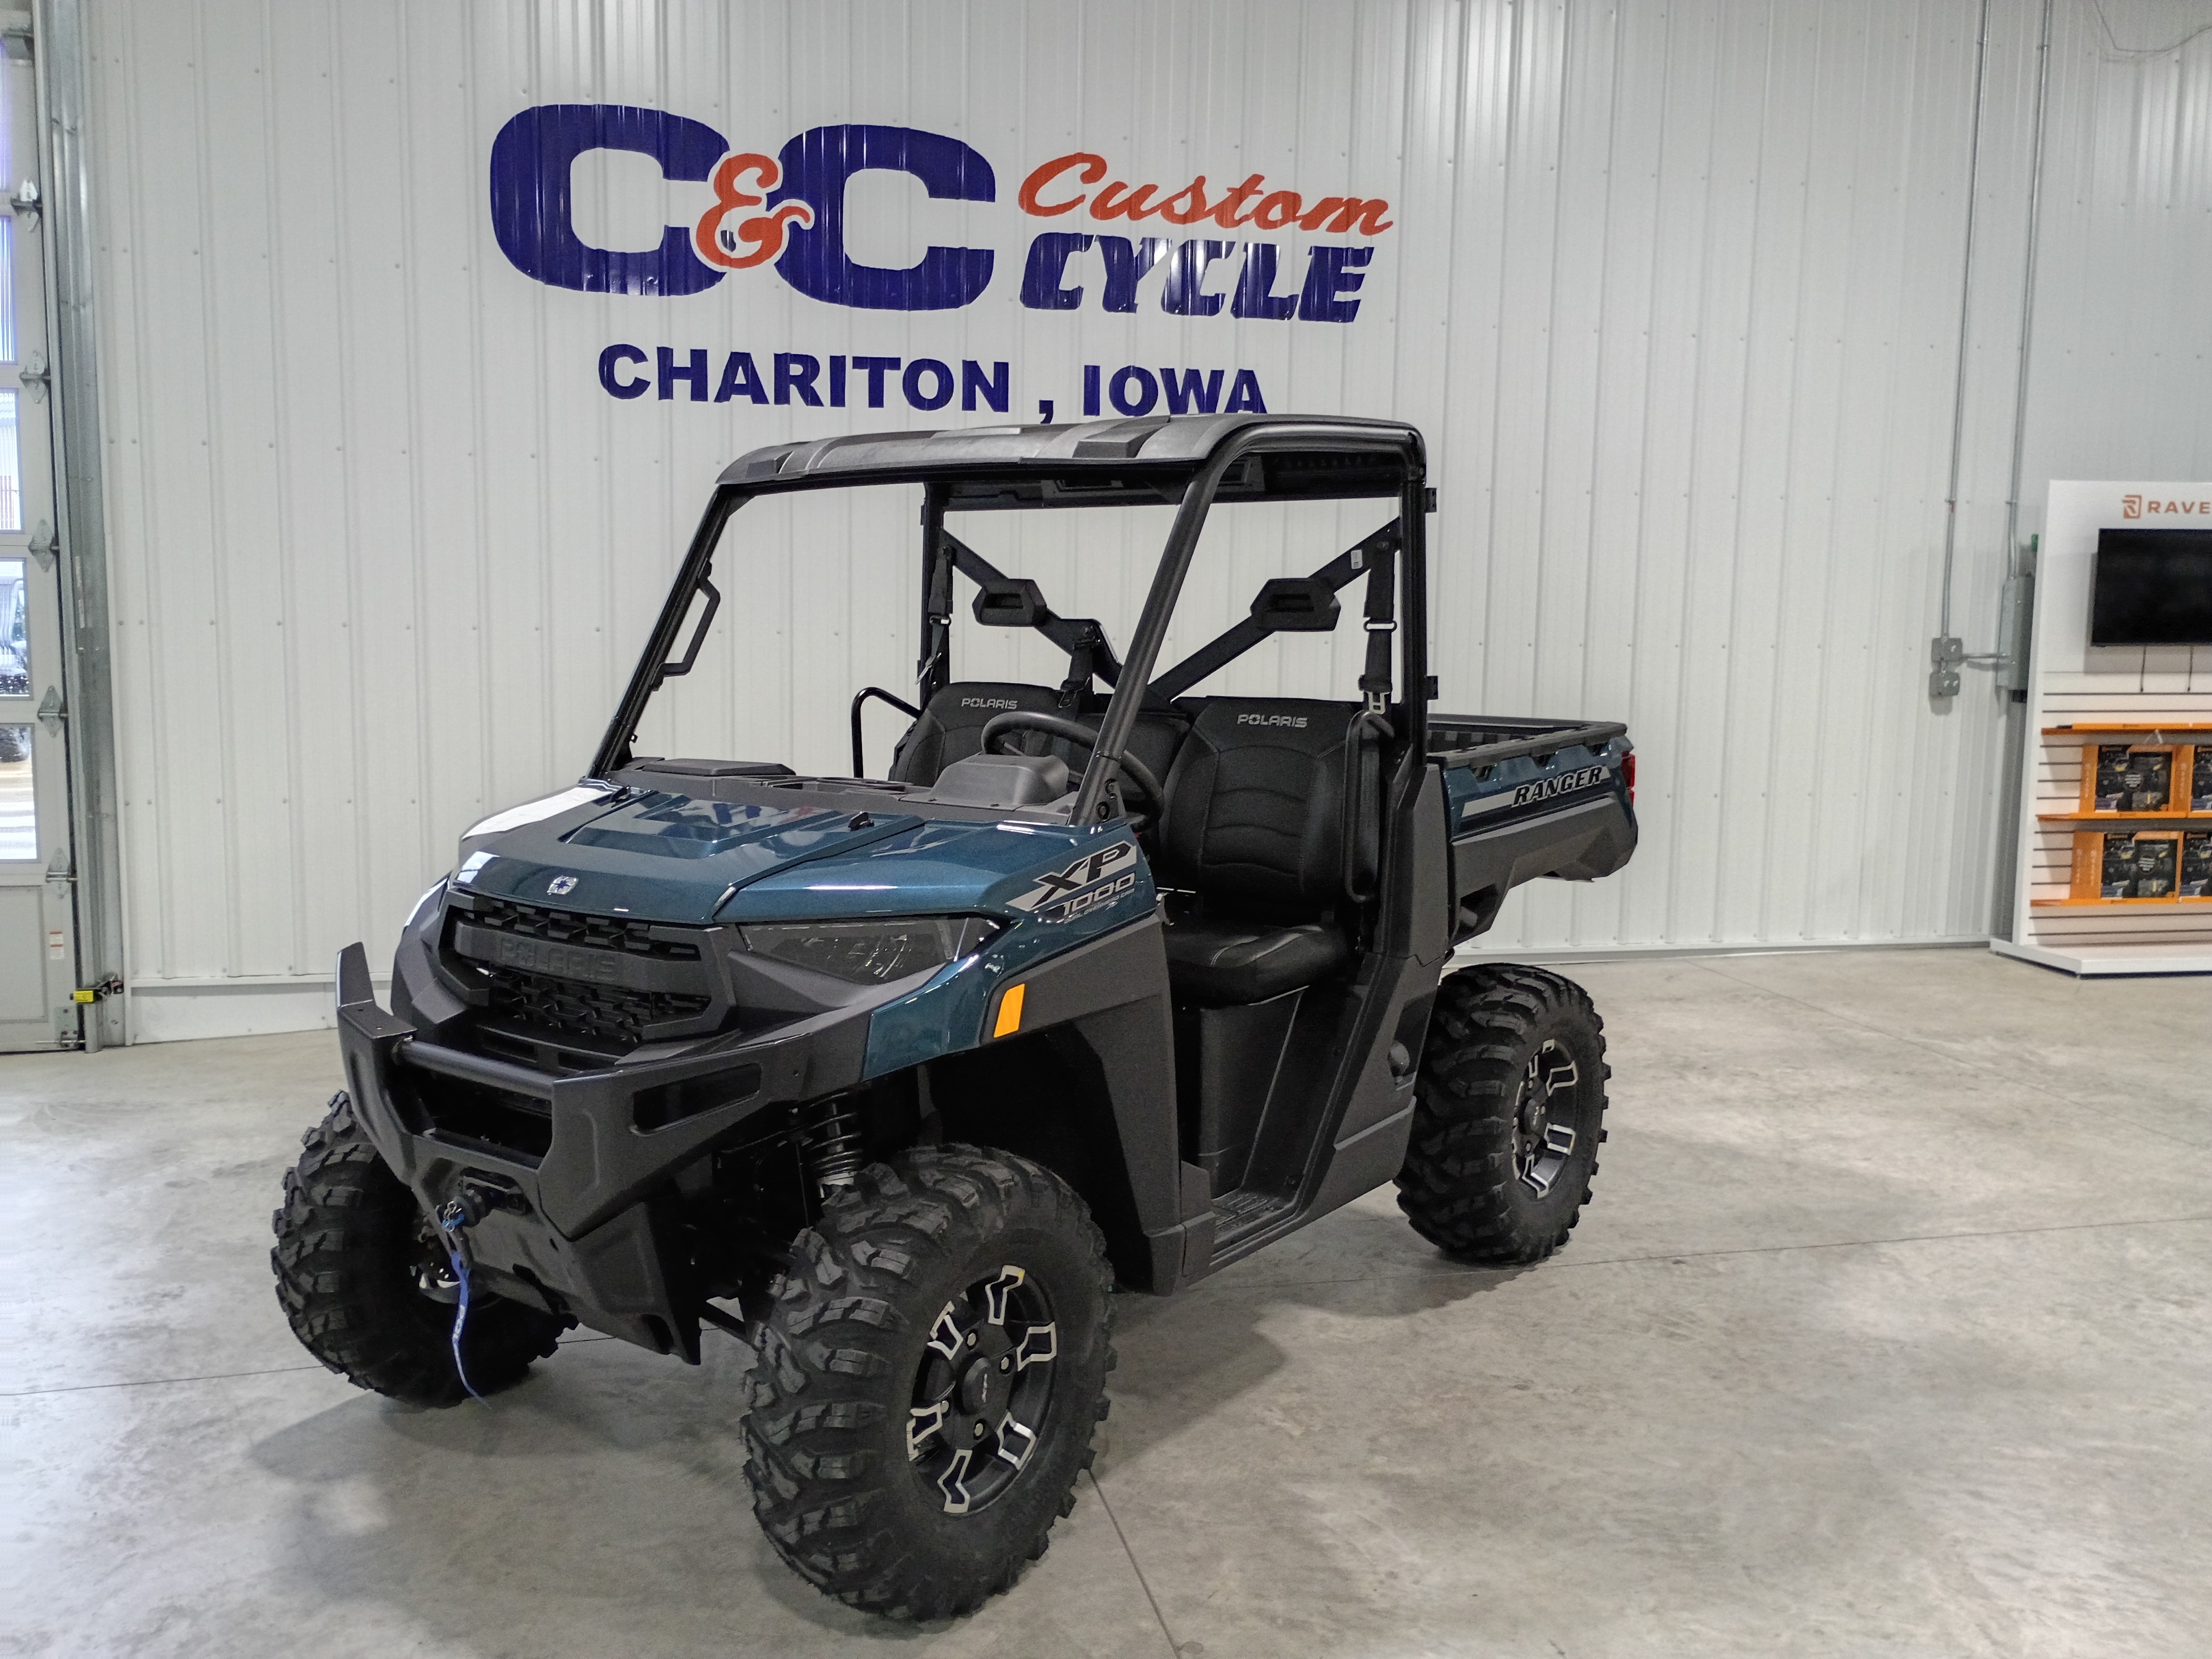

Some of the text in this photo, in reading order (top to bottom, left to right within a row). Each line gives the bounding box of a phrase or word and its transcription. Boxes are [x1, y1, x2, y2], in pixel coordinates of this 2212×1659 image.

[490, 104, 995, 311] C&C
[1018, 152, 1393, 235] Custom
[1020, 232, 1374, 323] CYCLE
[599, 344, 1009, 413] CHARITON
[1083, 365, 1267, 417] IOWA
[961, 698, 1018, 710] POLARIS
[1237, 714, 1307, 728] POLARIS
[1513, 766, 1602, 806] RANGER
[1031, 841, 1131, 908] XP
[1063, 872, 1135, 916] 1000
